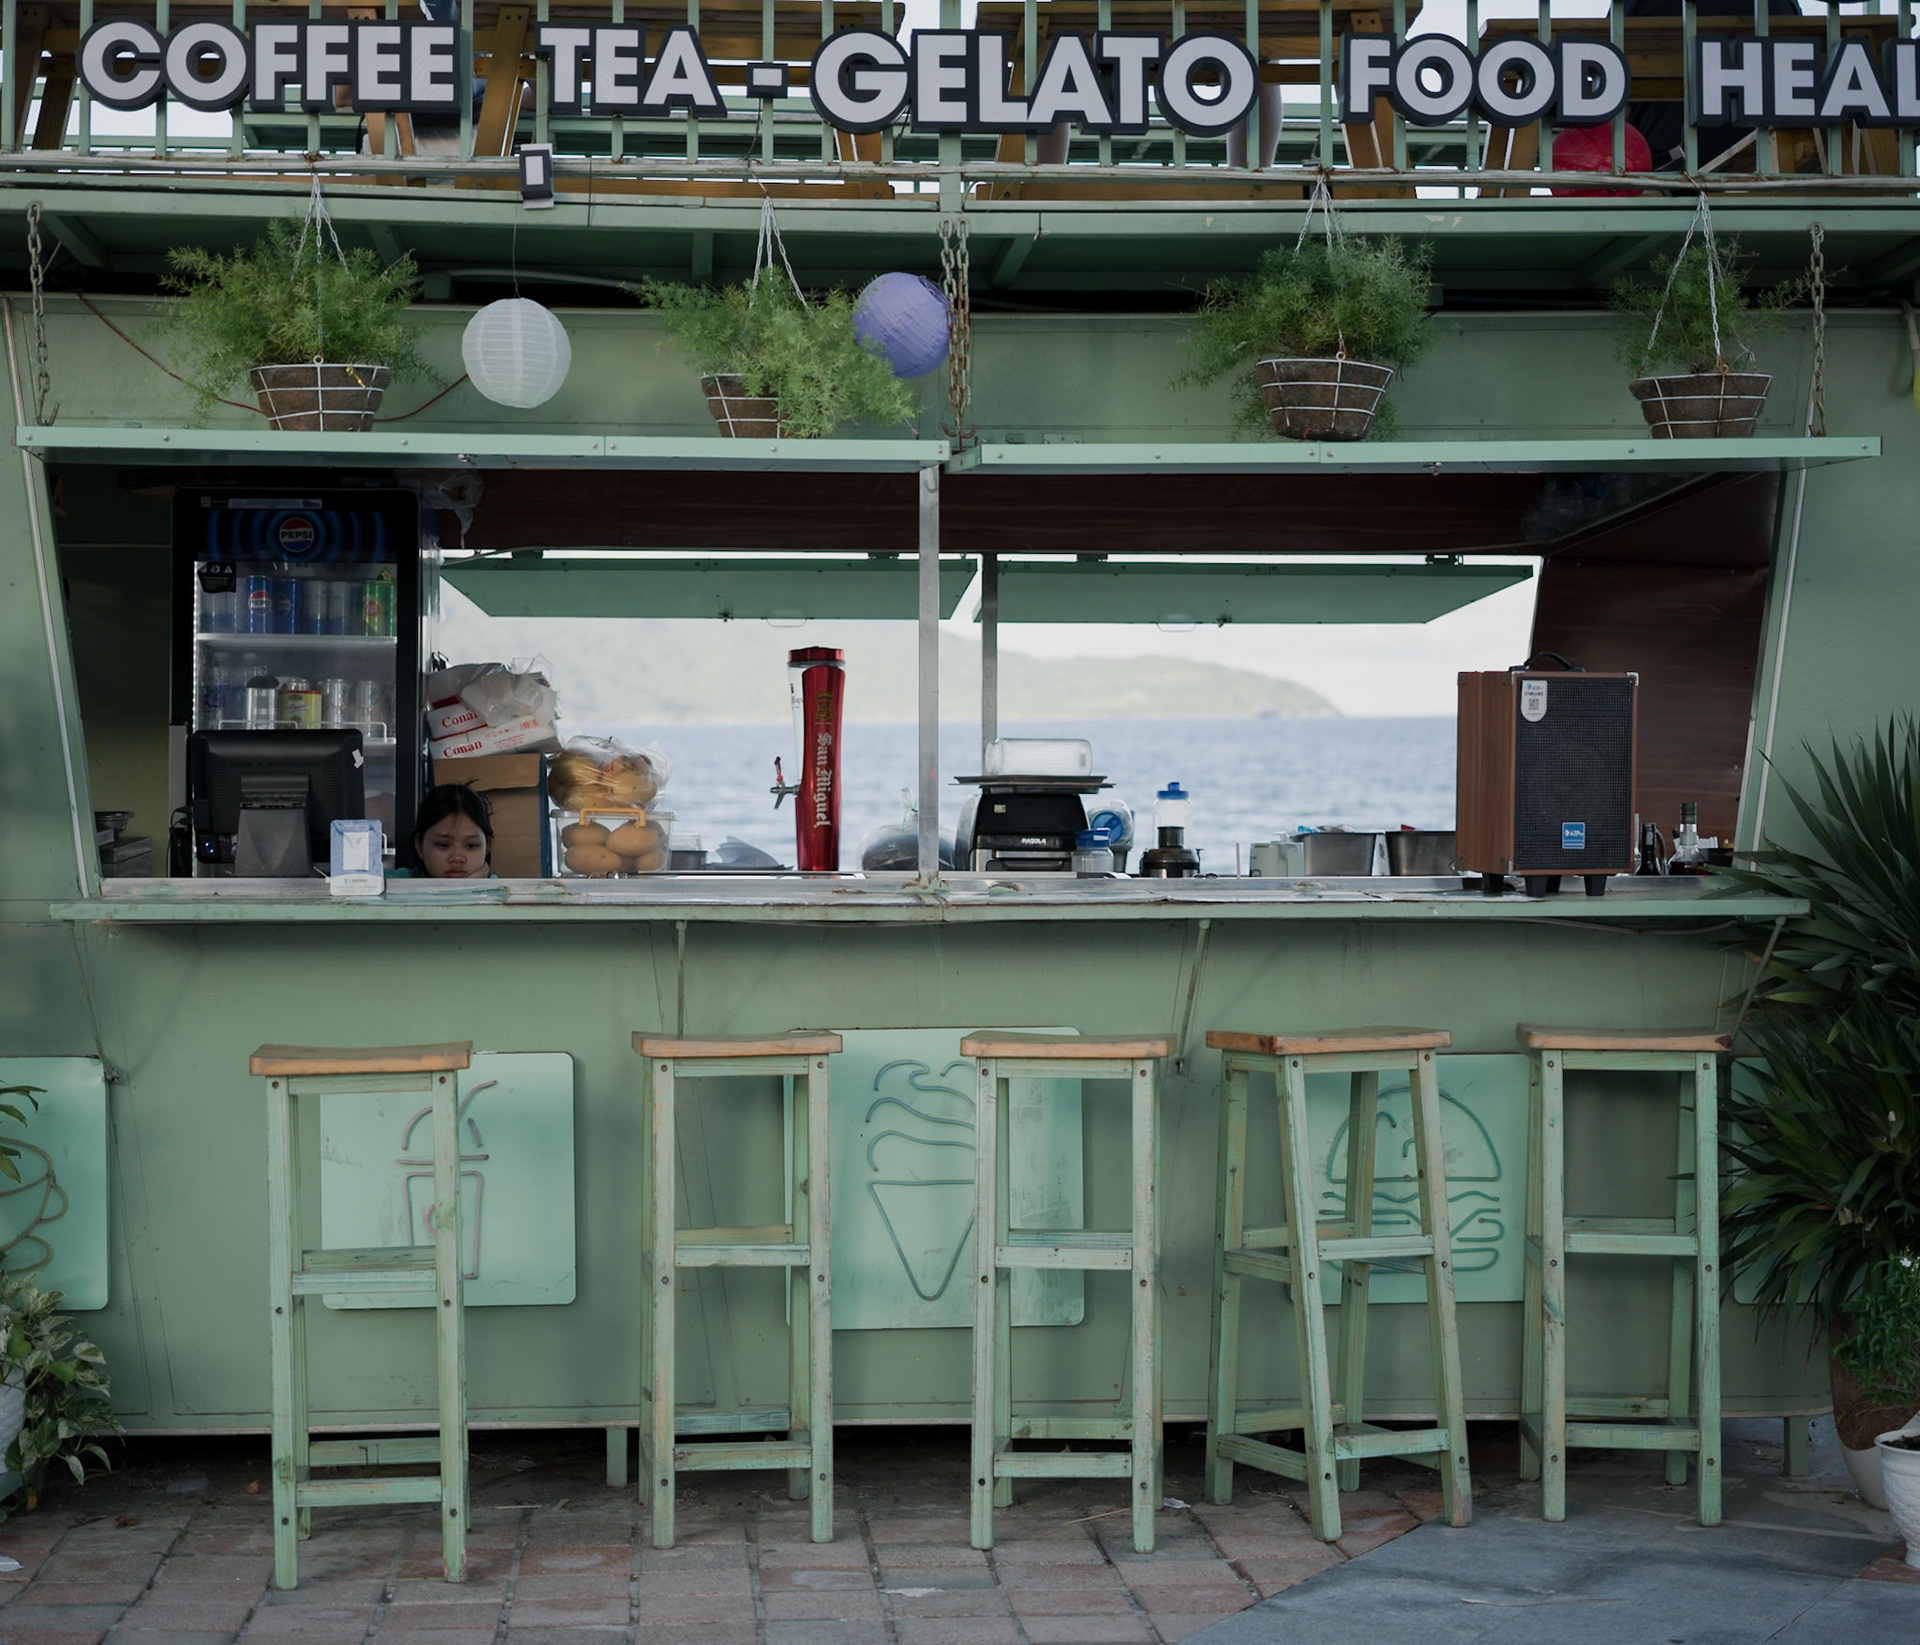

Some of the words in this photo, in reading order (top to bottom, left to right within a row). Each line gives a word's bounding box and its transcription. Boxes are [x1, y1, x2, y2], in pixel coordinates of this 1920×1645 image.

[81, 22, 455, 107] COFFEE
[539, 27, 718, 106] TEA
[814, 31, 1255, 125] GELATO
[1350, 38, 1627, 117] FOOD
[1702, 41, 1920, 117] HEAL
[281, 531, 312, 539] PEPSI
[443, 740, 483, 758] Conan
[816, 732, 833, 765] San
[813, 768, 833, 829] Miguel
